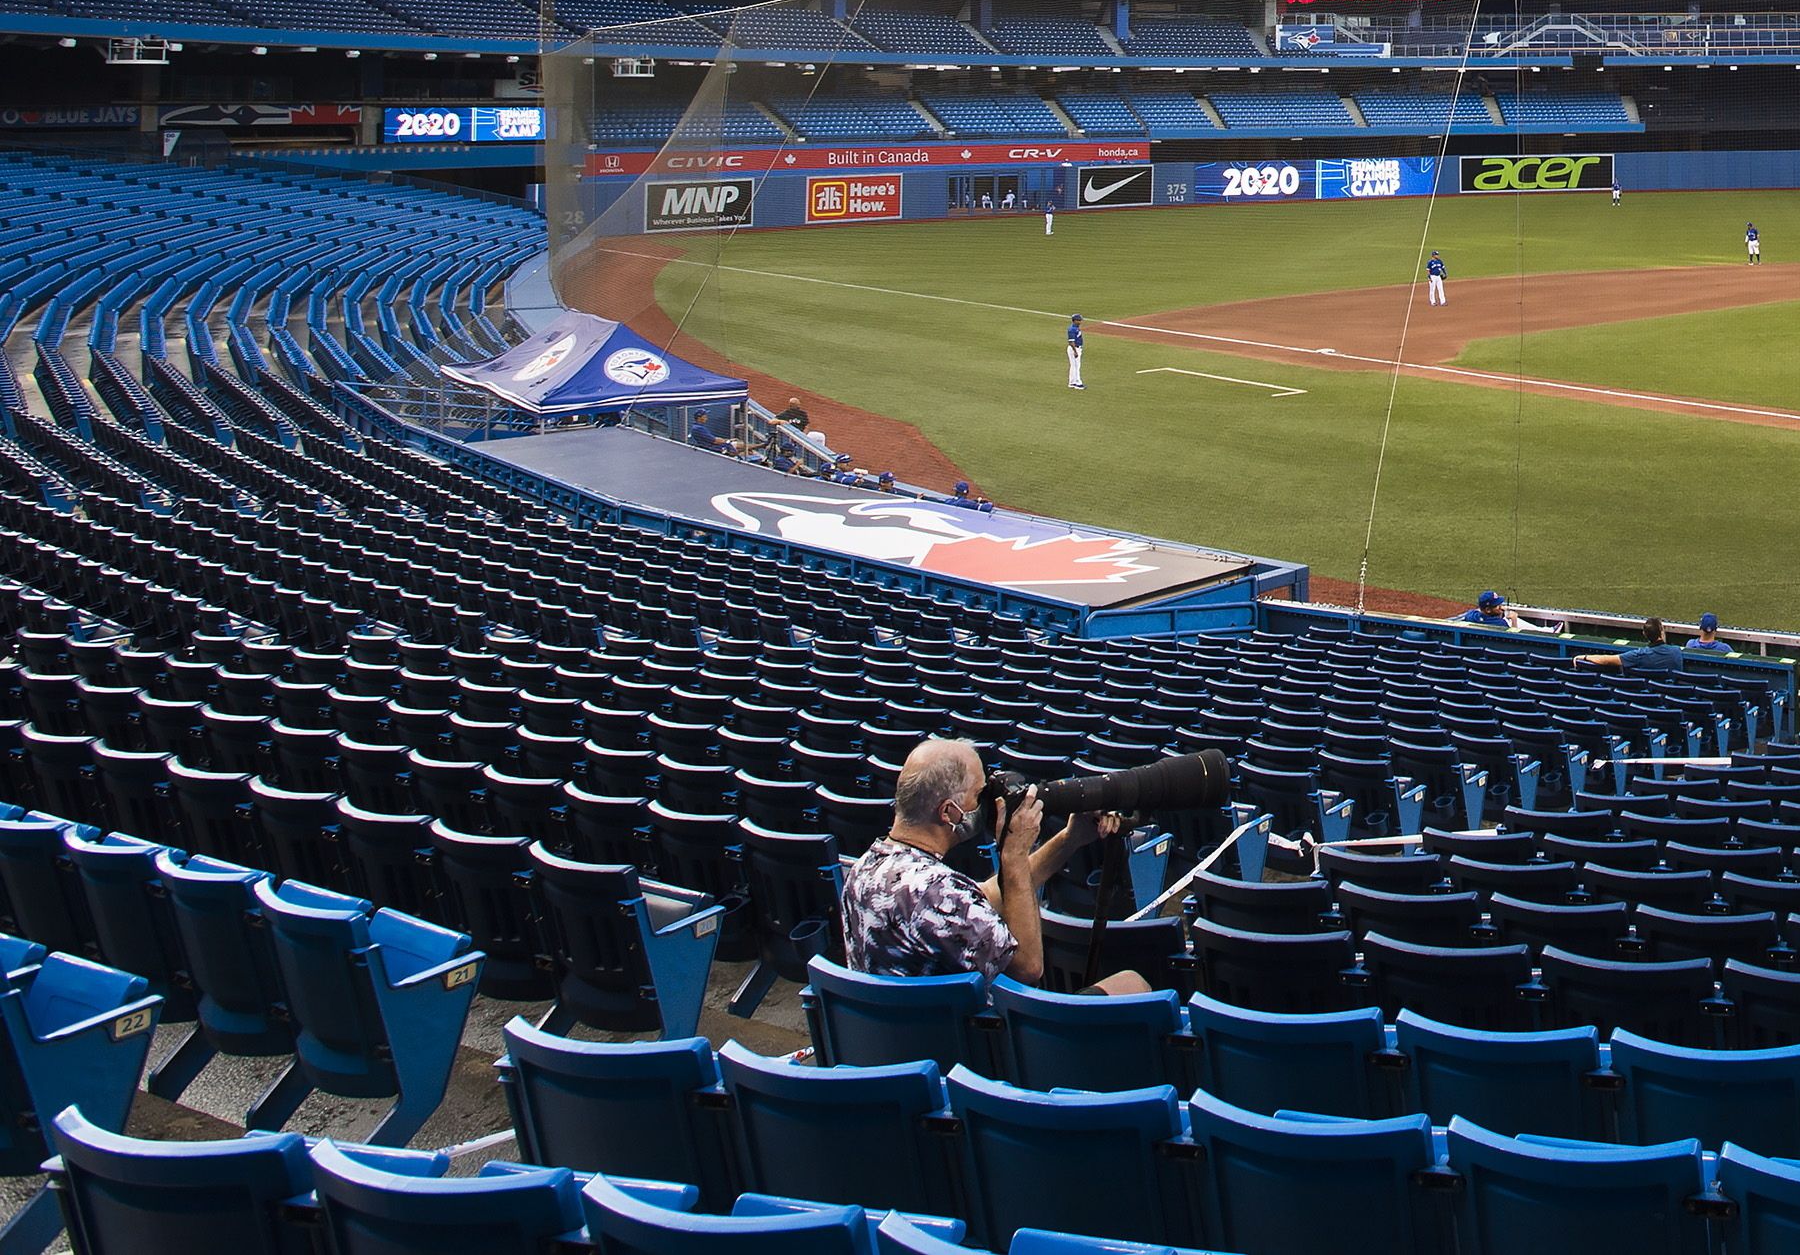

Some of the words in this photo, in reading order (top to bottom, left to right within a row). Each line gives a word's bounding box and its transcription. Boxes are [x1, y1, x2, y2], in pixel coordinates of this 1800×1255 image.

[45, 107, 90, 124] BLUE
[93, 106, 139, 124] JAYS
[396, 112, 462, 137] 2020
[500, 125, 542, 138] CAMP
[828, 150, 859, 165] Built
[862, 150, 874, 164] in
[878, 149, 930, 164] Canada
[1008, 148, 1062, 159] CR-V
[1098, 147, 1139, 157] honda.ca
[666, 155, 744, 169] CIVIC
[1351, 159, 1399, 170] SUMMER
[1222, 165, 1300, 196] 2020
[1351, 170, 1400, 181] TRAINING
[1473, 156, 1600, 190] acer
[850, 182, 896, 197] Here's
[1166, 183, 1187, 195] 375
[1350, 180, 1400, 197] CAMP
[660, 185, 740, 216] MNP
[850, 199, 887, 213] How.
[652, 218, 686, 226] Wherever
[686, 216, 715, 225] Business
[454, 968, 470, 984] 21
[122, 1014, 144, 1030] 22
